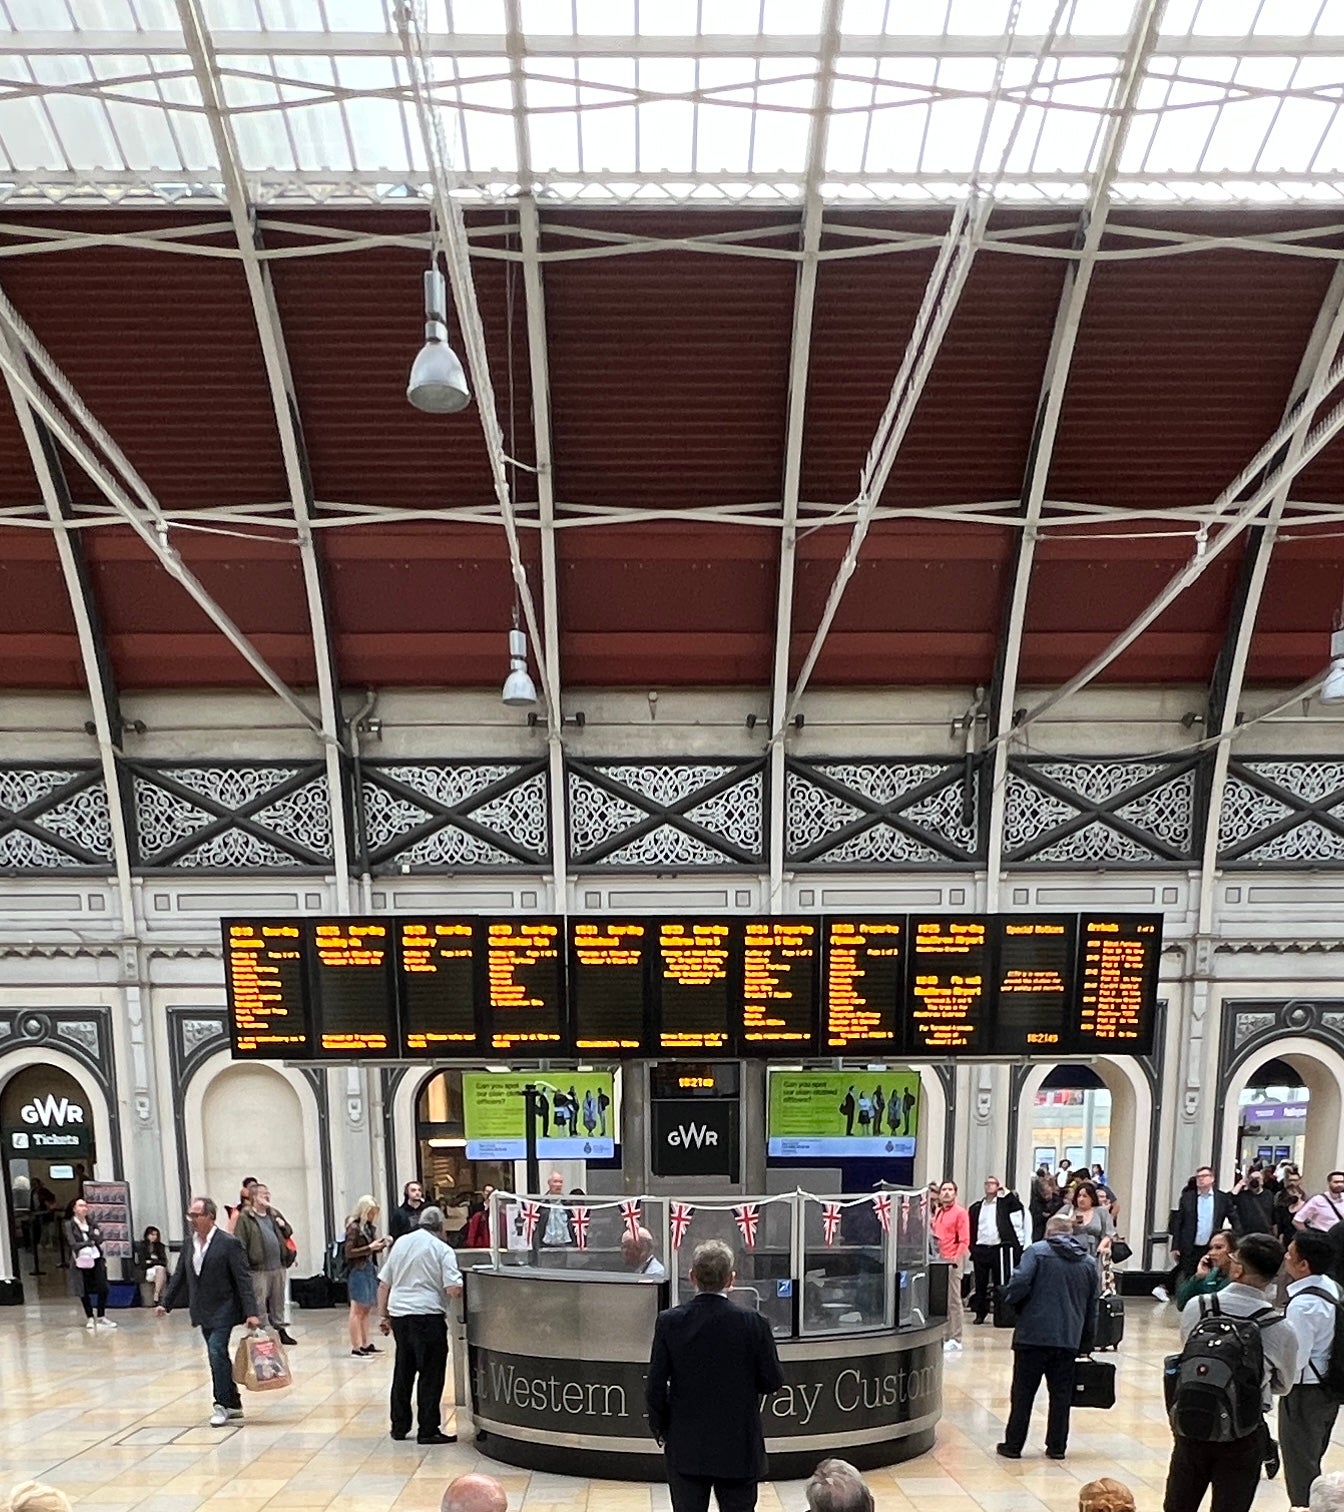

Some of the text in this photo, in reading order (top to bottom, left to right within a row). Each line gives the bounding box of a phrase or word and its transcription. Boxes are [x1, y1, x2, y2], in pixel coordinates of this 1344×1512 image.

[21, 1094, 84, 1126] GWR
[33, 1133, 79, 1146] Tickets
[668, 1121, 718, 1149] GWR
[490, 1362, 629, 1417] Western
